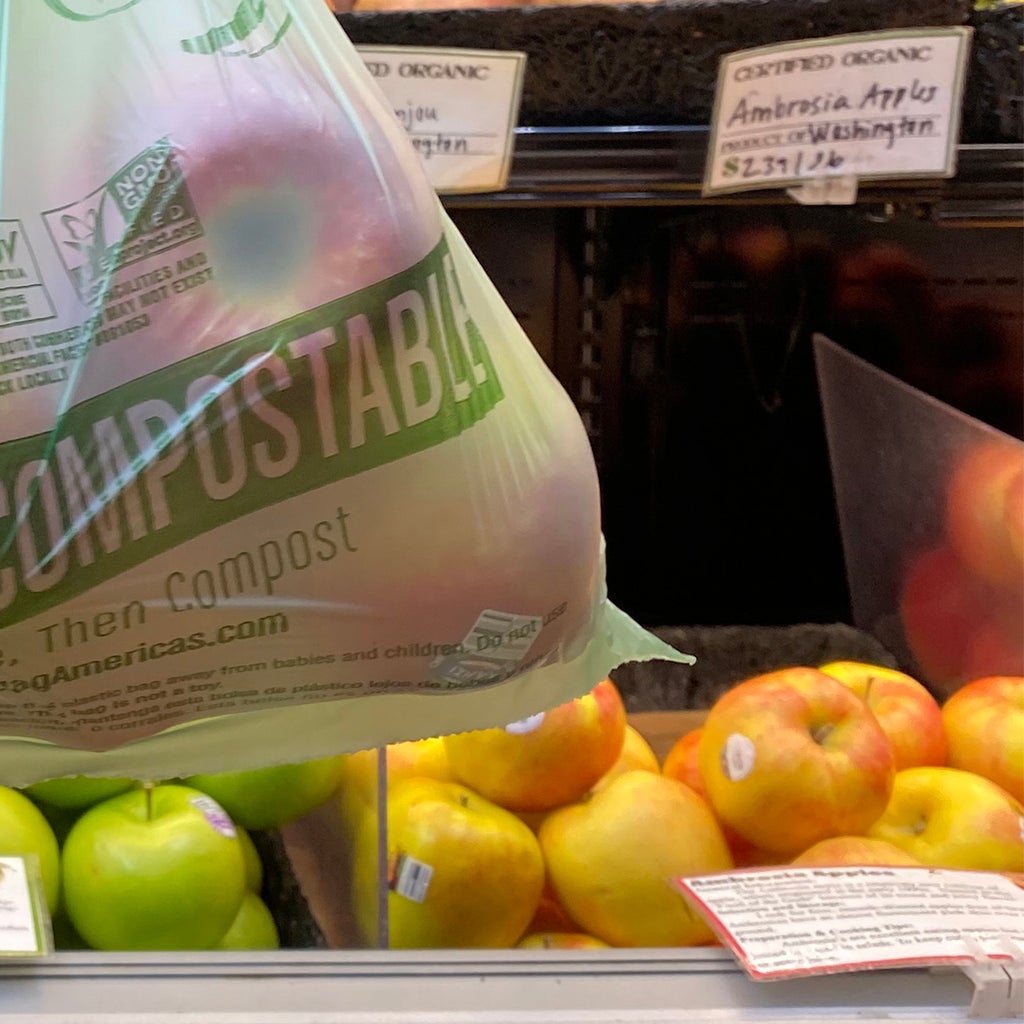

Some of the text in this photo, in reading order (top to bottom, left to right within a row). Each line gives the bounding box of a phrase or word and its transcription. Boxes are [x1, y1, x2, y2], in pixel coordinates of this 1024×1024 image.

[398, 63, 490, 80] ORGANIC
[734, 45, 934, 82] CERTIFIED ORGANIC
[728, 79, 938, 127] Ambrosia Apples
[809, 117, 934, 149] Washington
[38, 599, 146, 653] Then
[165, 505, 357, 618] Compost
[127, 679, 161, 694] bag
[220, 661, 267, 675] from
[272, 653, 336, 670] babies
[342, 647, 378, 663] and
[477, 633, 502, 652] Do
[136, 690, 167, 704] not
[264, 686, 286, 695] de
